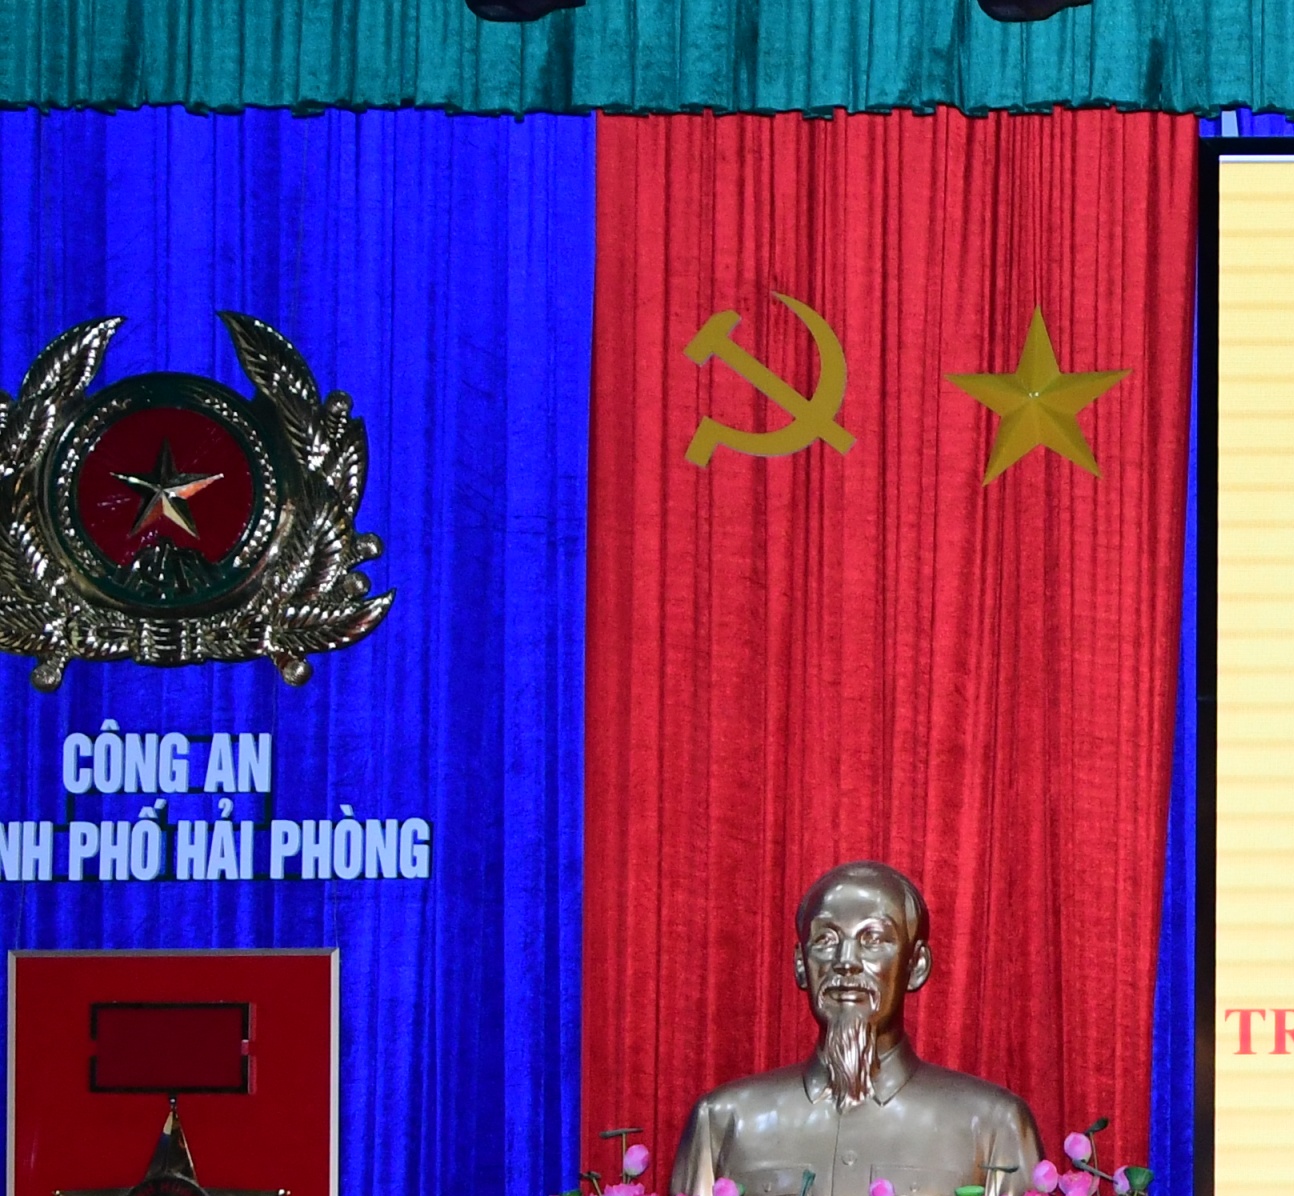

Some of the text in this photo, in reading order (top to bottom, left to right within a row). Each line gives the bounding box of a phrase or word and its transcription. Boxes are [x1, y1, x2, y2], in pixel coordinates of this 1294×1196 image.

[62, 718, 272, 794] CÔNG AN
[68, 798, 166, 882] PHỐ
[176, 797, 254, 881] HẢI
[270, 804, 431, 880] PHÒNG
